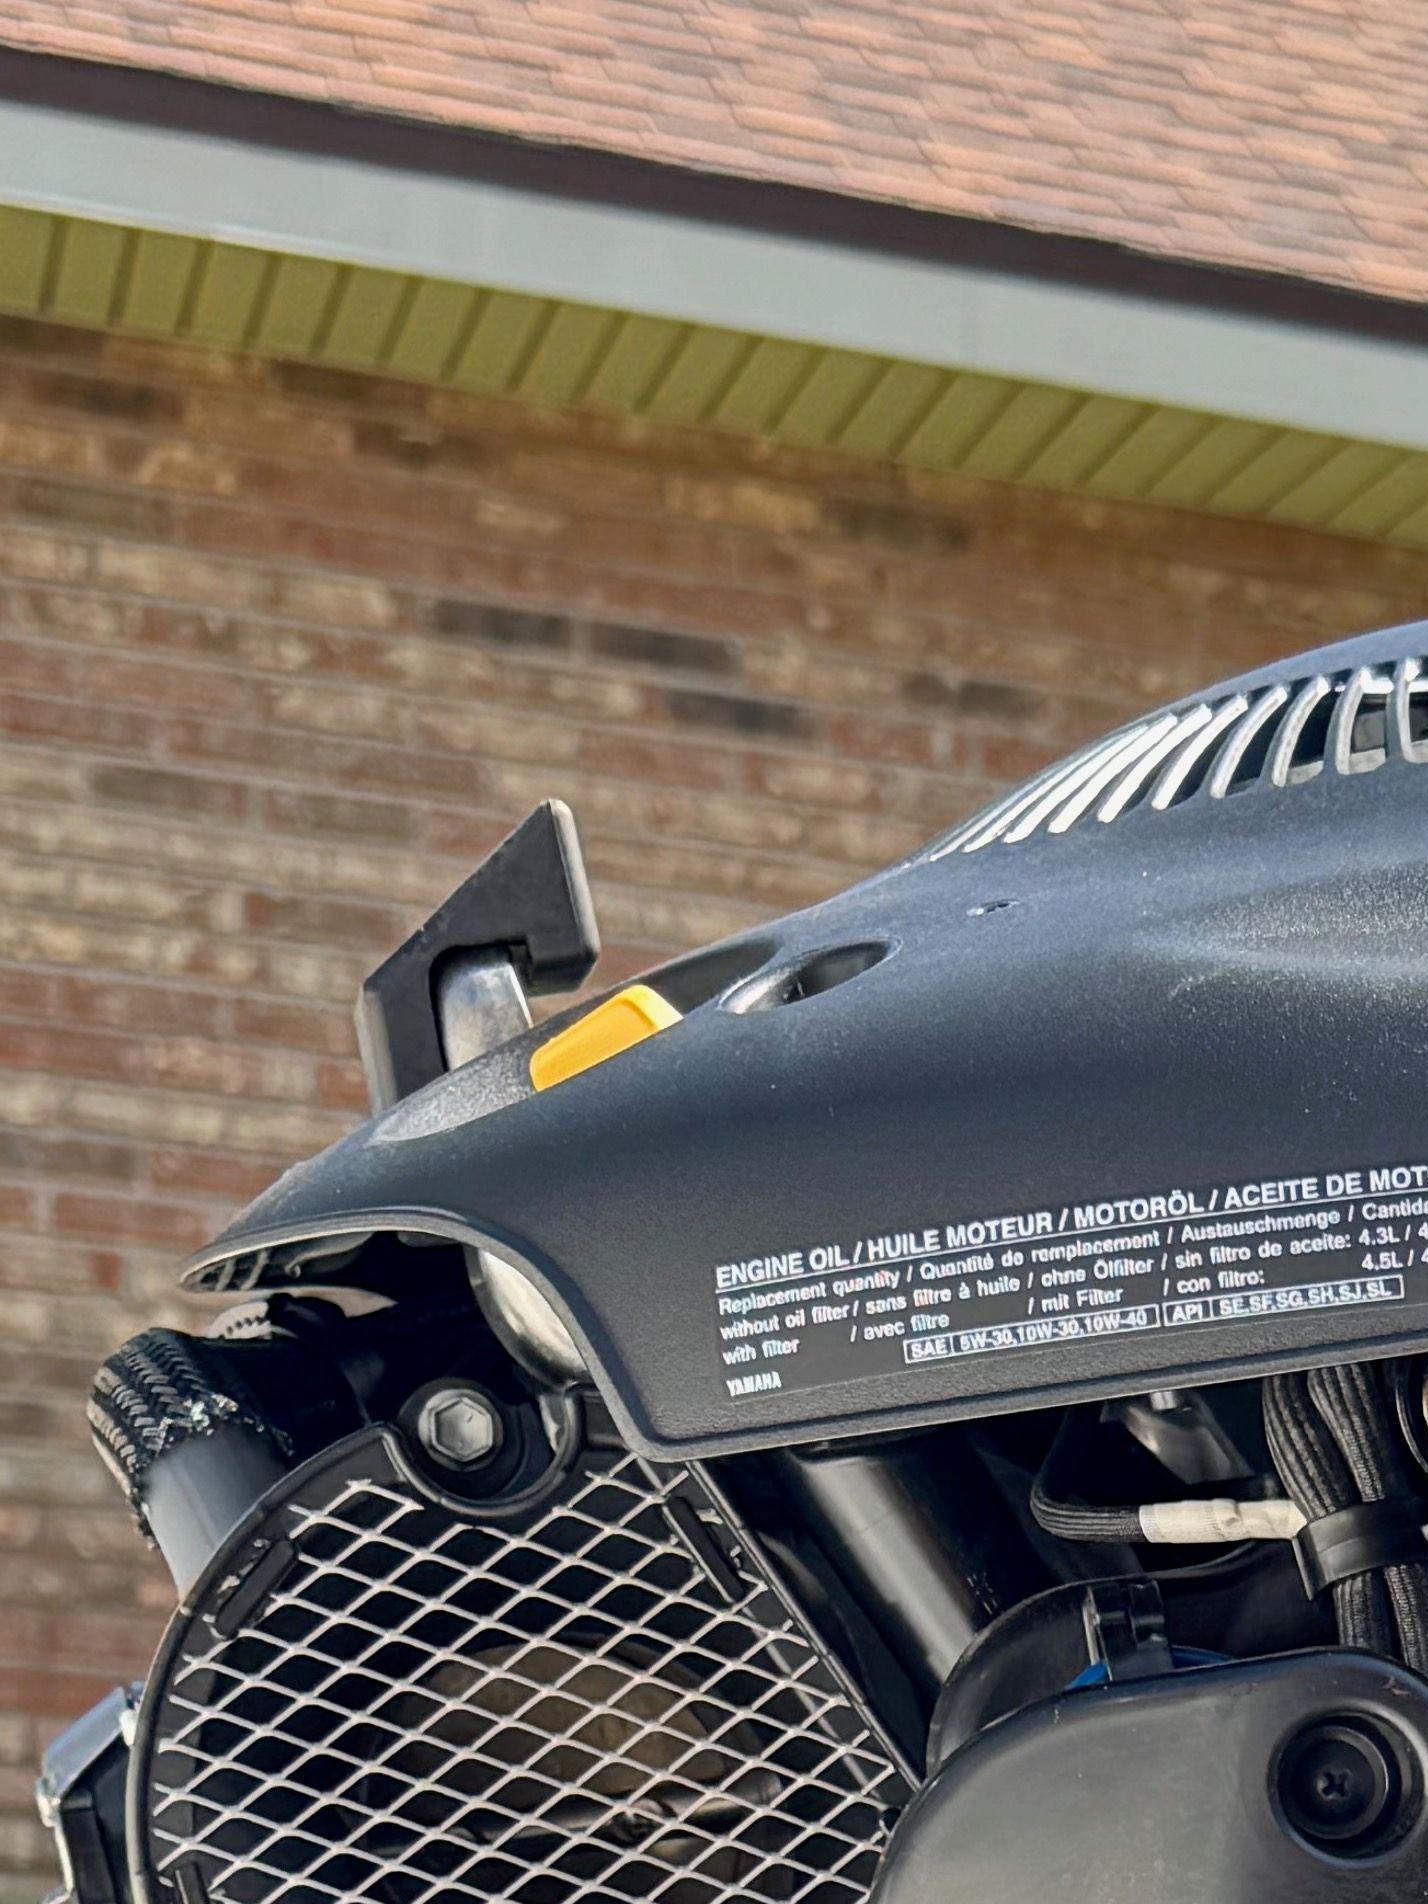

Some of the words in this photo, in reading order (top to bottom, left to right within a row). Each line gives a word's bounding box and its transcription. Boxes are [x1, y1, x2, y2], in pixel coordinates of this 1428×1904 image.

[716, 1252, 806, 1289] ENGINE
[809, 1245, 850, 1270] OIL
[867, 1230, 942, 1262] HUILE
[946, 1212, 1054, 1248] MOTEUR
[1074, 1186, 1209, 1230] MOTORÖL
[1224, 1178, 1319, 1209] ACEITE
[1326, 1172, 1363, 1196] DE
[718, 1282, 827, 1315] Replacement
[833, 1270, 899, 1296] quantity
[919, 1254, 994, 1280] Quantité
[1001, 1251, 1024, 1267] de
[1031, 1231, 1160, 1262] remplacement
[1181, 1210, 1340, 1243] Austauschmenge
[720, 1315, 780, 1340] without
[785, 1309, 805, 1328] oil
[866, 1296, 907, 1314] sans
[913, 1288, 952, 1307] filtre
[958, 1282, 971, 1299] à
[977, 1276, 1020, 1296] huile
[1041, 1269, 1086, 1287] ohne
[1094, 1258, 1154, 1279] Ölfilter
[1175, 1251, 1202, 1269] sin
[1210, 1246, 1251, 1264] filtro
[1258, 1241, 1282, 1258] de
[1290, 1234, 1351, 1254] aceite:
[1358, 1226, 1400, 1246] 4.3L
[723, 1344, 756, 1365] with
[762, 1339, 799, 1358] filter
[864, 1321, 905, 1340] avec
[910, 1314, 949, 1332] filtre
[1041, 1293, 1069, 1312] mit
[1076, 1289, 1122, 1307] Filter
[1177, 1277, 1211, 1294] con
[1218, 1270, 1265, 1288] filtro:
[1361, 1251, 1404, 1270] 4.5L
[911, 1339, 947, 1358] SAE
[1172, 1303, 1203, 1322] API
[727, 1372, 782, 1396] YAMAHA
